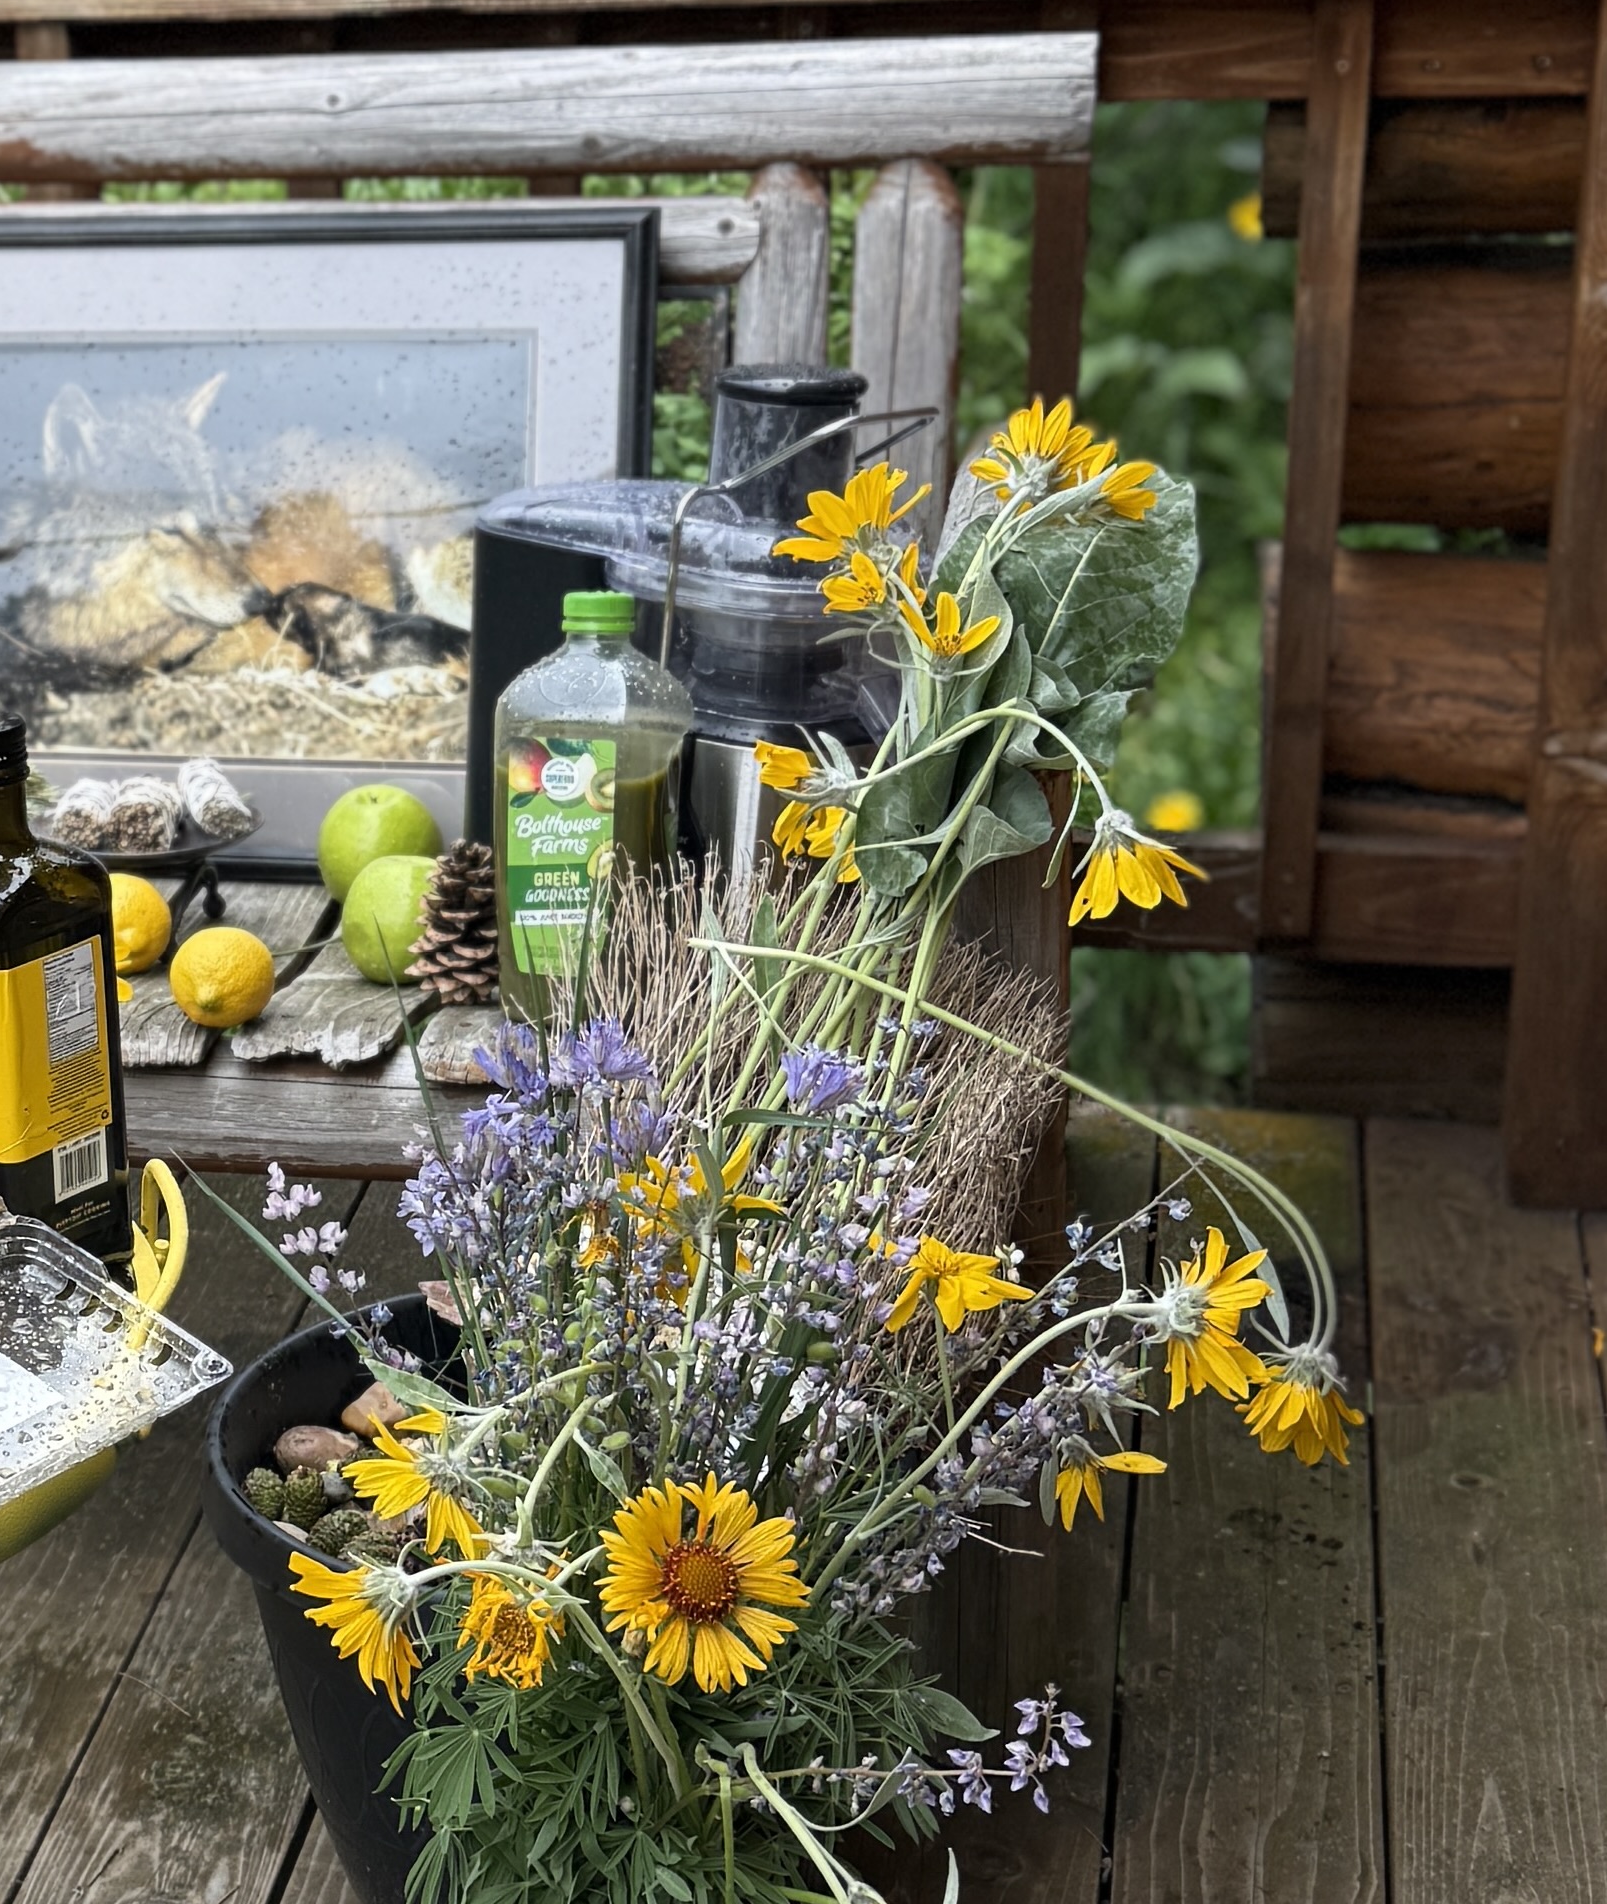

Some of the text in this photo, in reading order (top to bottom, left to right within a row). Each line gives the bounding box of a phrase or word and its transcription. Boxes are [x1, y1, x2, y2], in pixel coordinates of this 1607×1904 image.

[515, 811, 602, 838] Bolthouse
[530, 835, 589, 858] Farms
[533, 871, 580, 887] GREEN
[524, 886, 591, 903] GOODNESS
